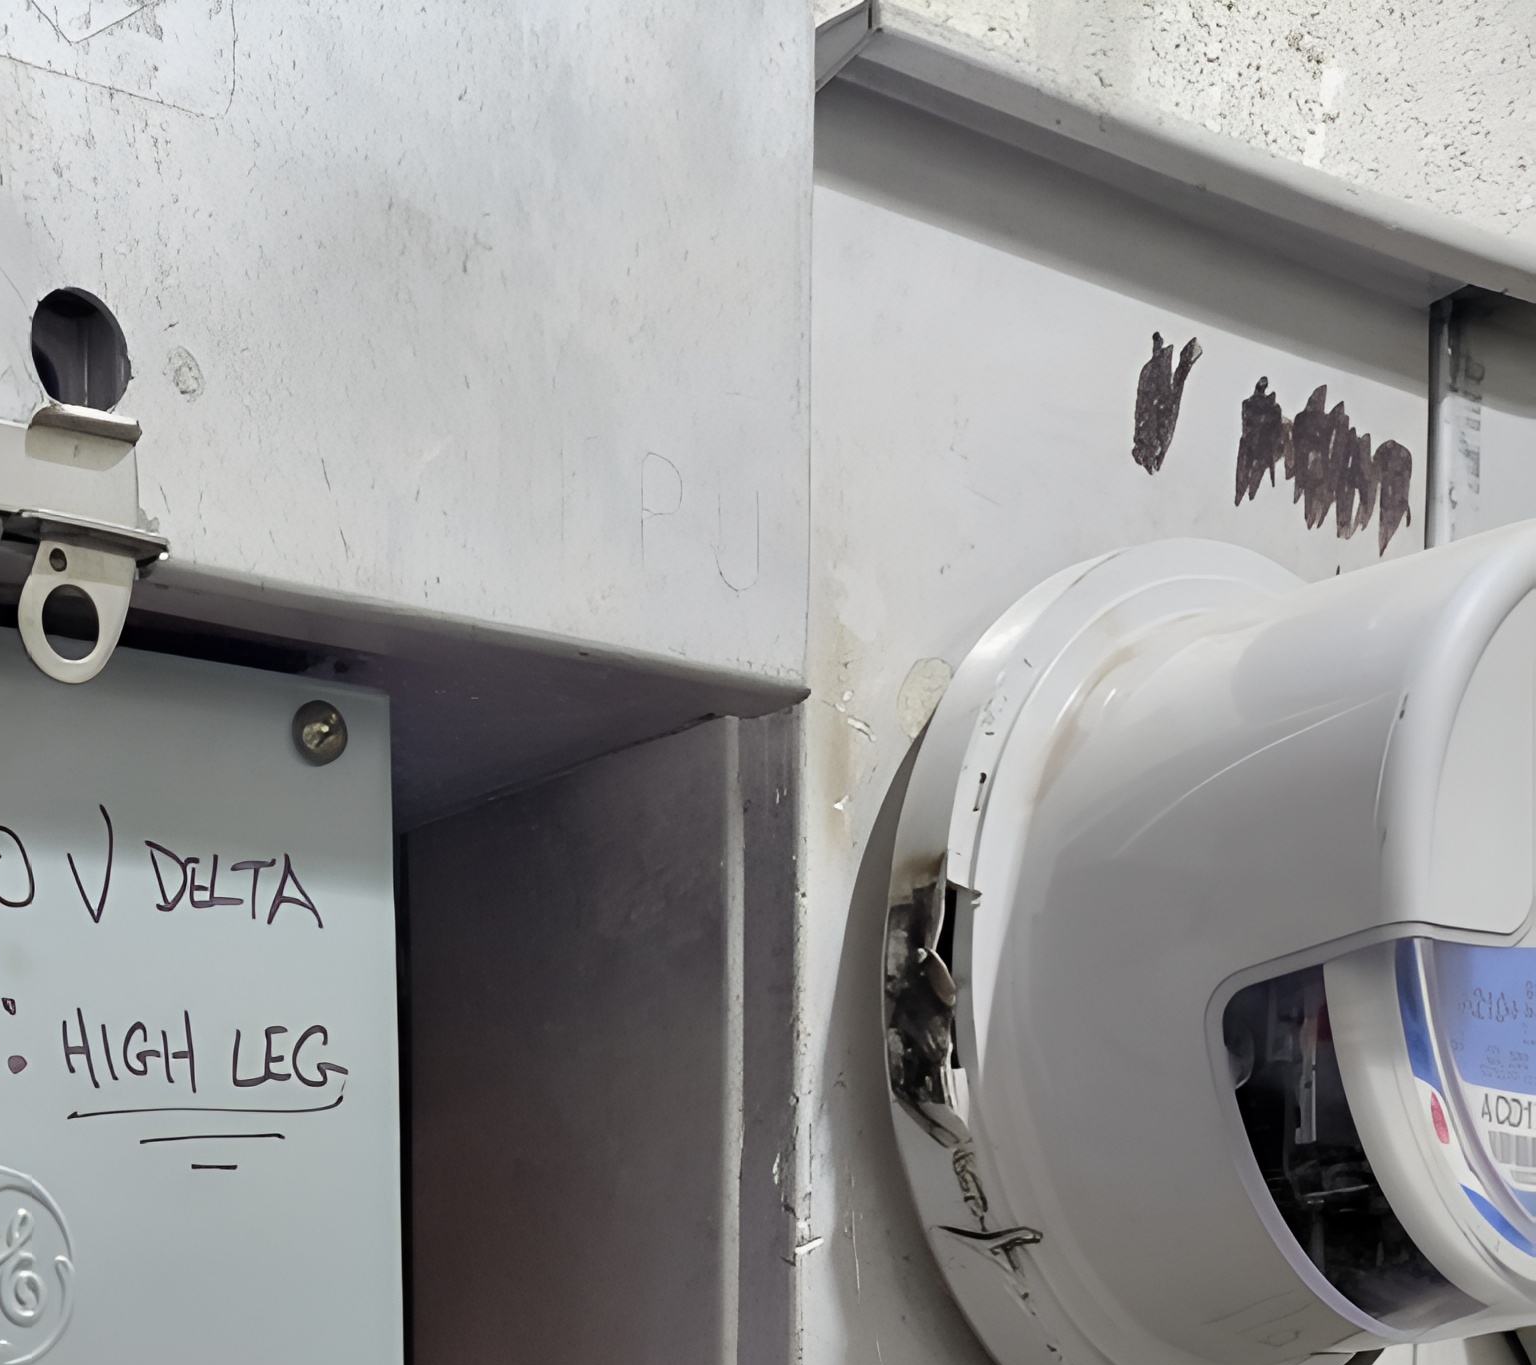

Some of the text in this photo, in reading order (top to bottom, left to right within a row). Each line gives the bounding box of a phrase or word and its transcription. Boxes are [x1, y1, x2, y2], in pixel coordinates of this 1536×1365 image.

[67, 804, 114, 924] V
[145, 840, 326, 929] DELTA
[62, 1008, 198, 1093] HIGH
[231, 1024, 350, 1089] LEG
